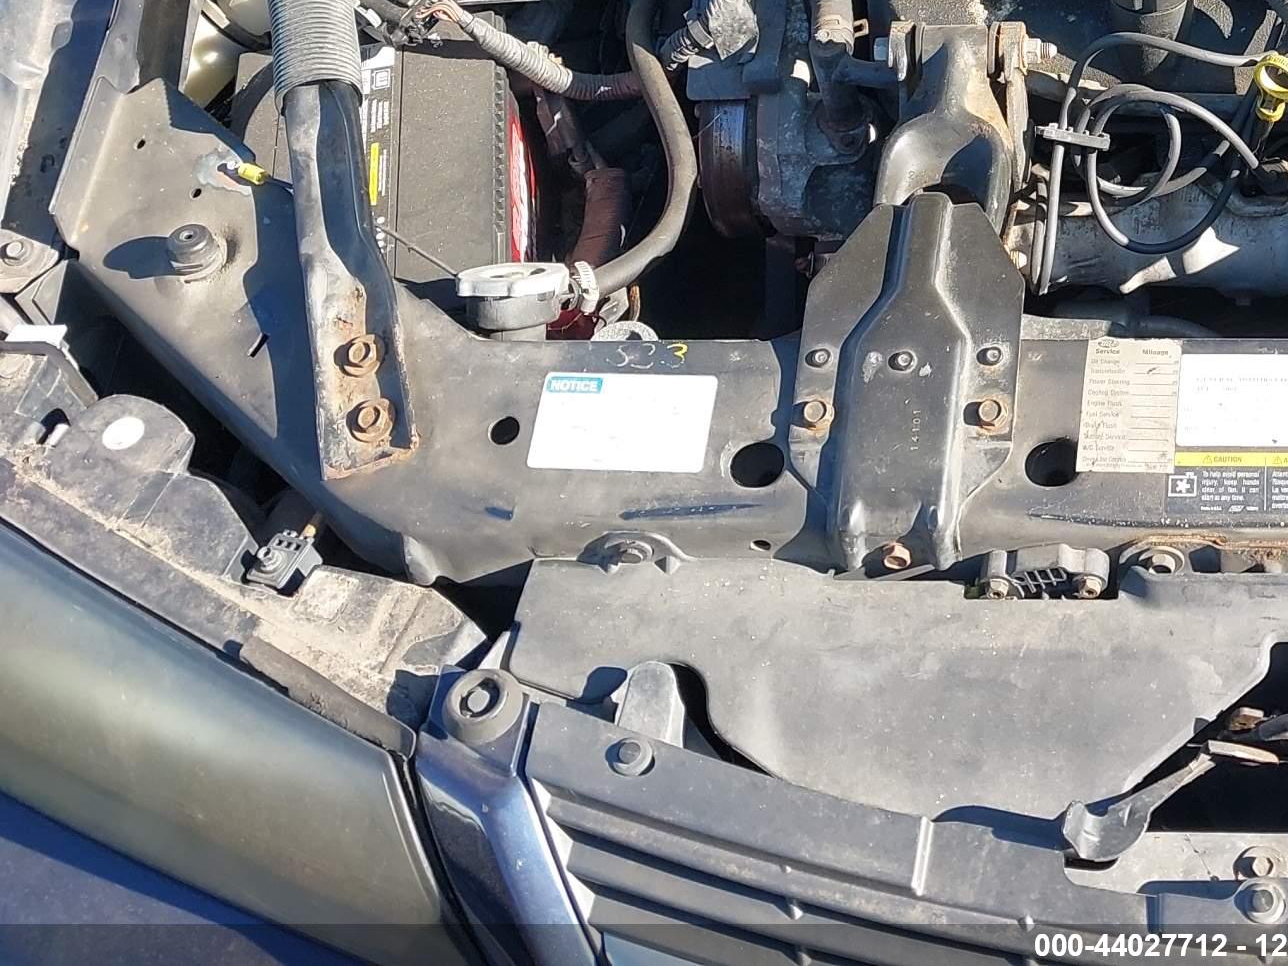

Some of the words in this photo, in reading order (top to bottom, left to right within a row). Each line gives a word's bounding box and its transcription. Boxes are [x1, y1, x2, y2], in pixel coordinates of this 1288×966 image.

[550, 379, 598, 392] NOTICE
[1237, 471, 1260, 479] personal
[1202, 479, 1218, 487] injury,
[1223, 479, 1238, 487] keep
